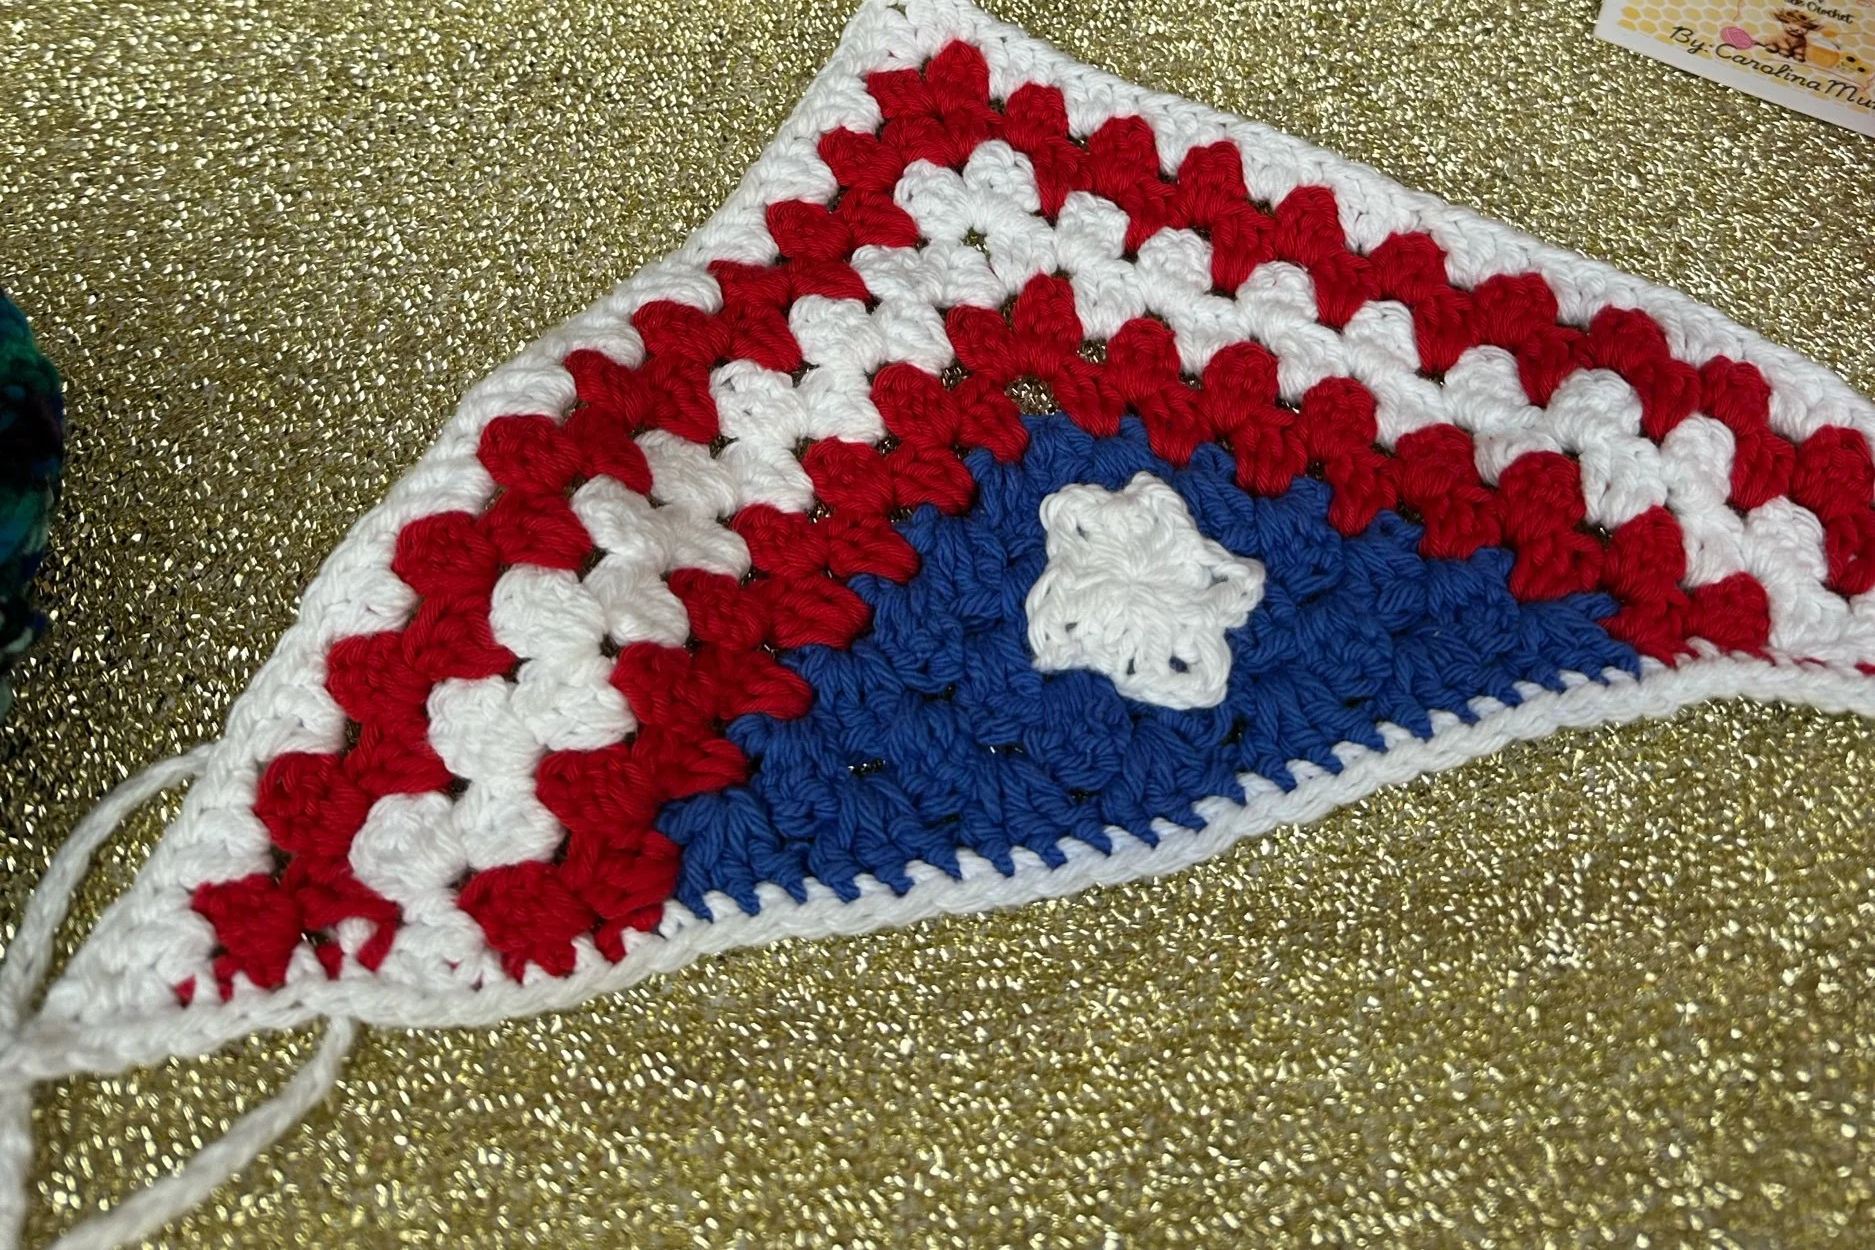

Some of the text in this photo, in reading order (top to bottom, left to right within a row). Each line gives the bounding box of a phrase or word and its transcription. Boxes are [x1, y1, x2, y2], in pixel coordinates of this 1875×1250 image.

[1807, 1, 1855, 24] Crochet
[1669, 25, 1712, 53] By:
[1715, 43, 1820, 91] Carolina
